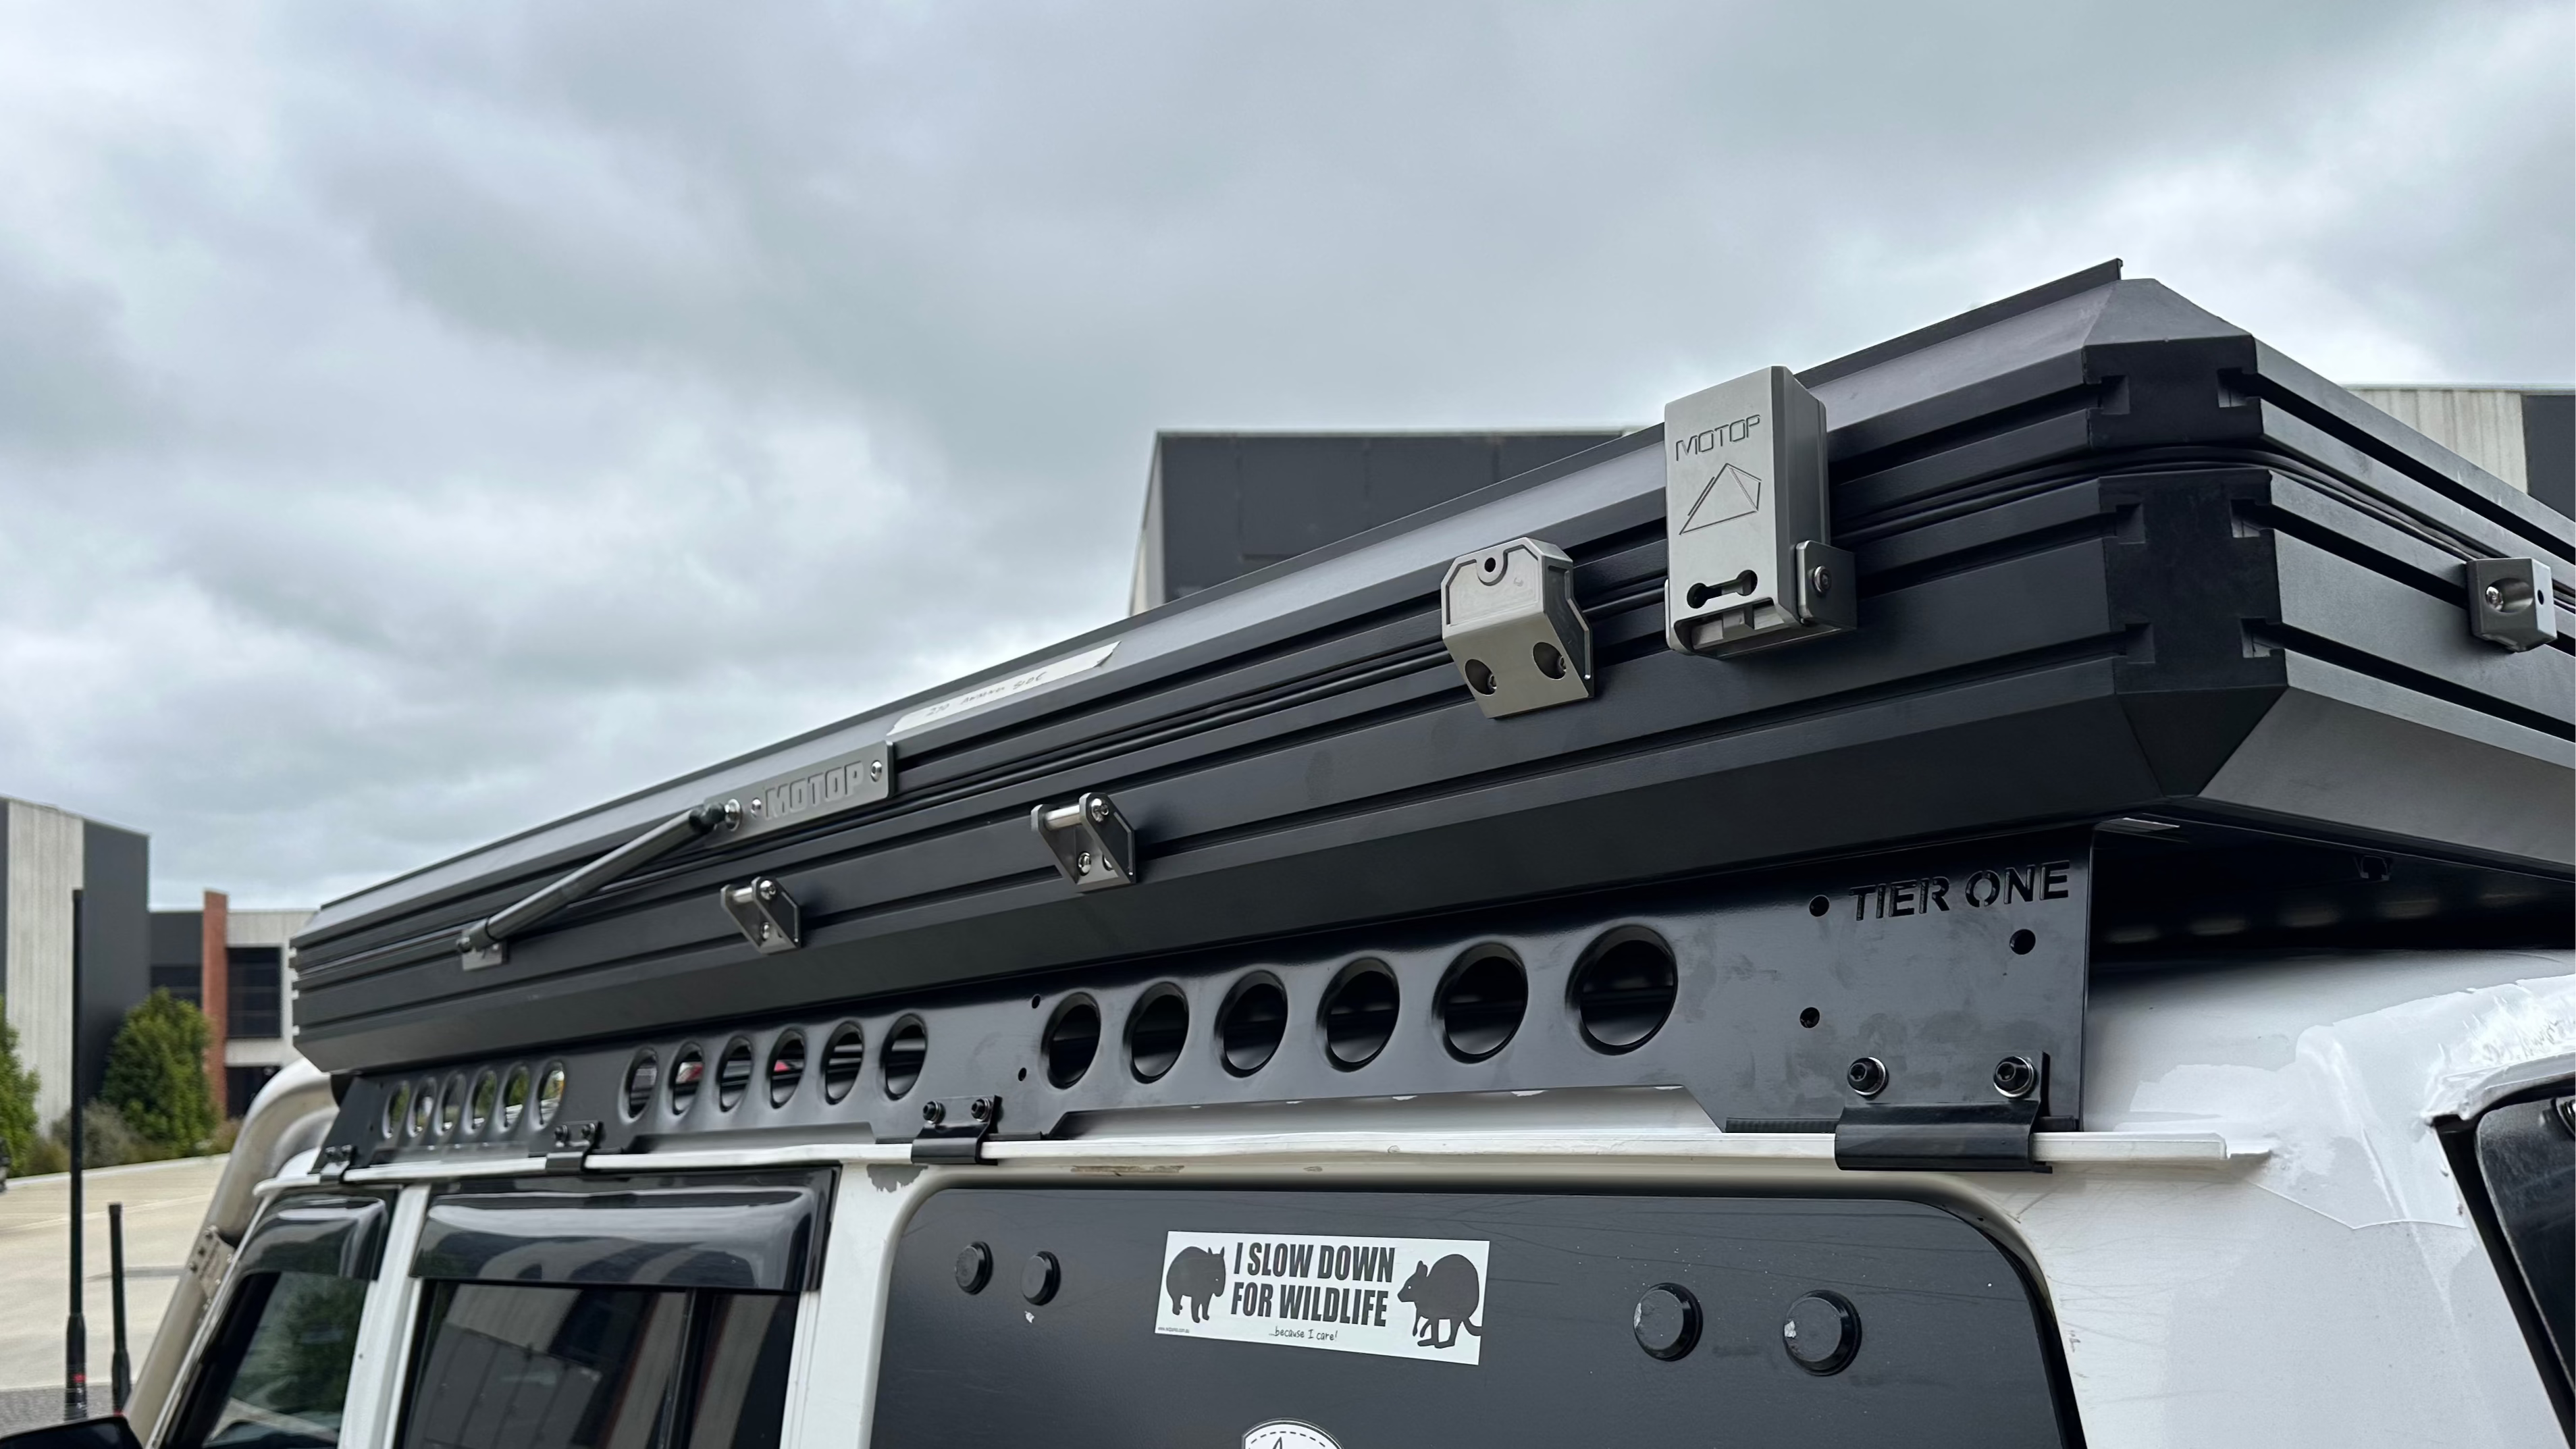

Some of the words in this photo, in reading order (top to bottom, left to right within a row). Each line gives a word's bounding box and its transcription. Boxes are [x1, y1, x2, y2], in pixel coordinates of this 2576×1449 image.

[1675, 414, 1760, 461] MOTOP
[764, 760, 864, 821] MOTOP
[1849, 876, 1951, 921] TIER
[1965, 860, 2071, 907] ONE
[1234, 1242, 1243, 1275] I
[1247, 1242, 1313, 1279] SLOW
[1317, 1245, 1395, 1283] DOWN
[1231, 1282, 1273, 1317] FOR
[1279, 1284, 1388, 1327] WILDLIFE
[1308, 1329, 1314, 1339] I
[1316, 1330, 1338, 1341] care!
